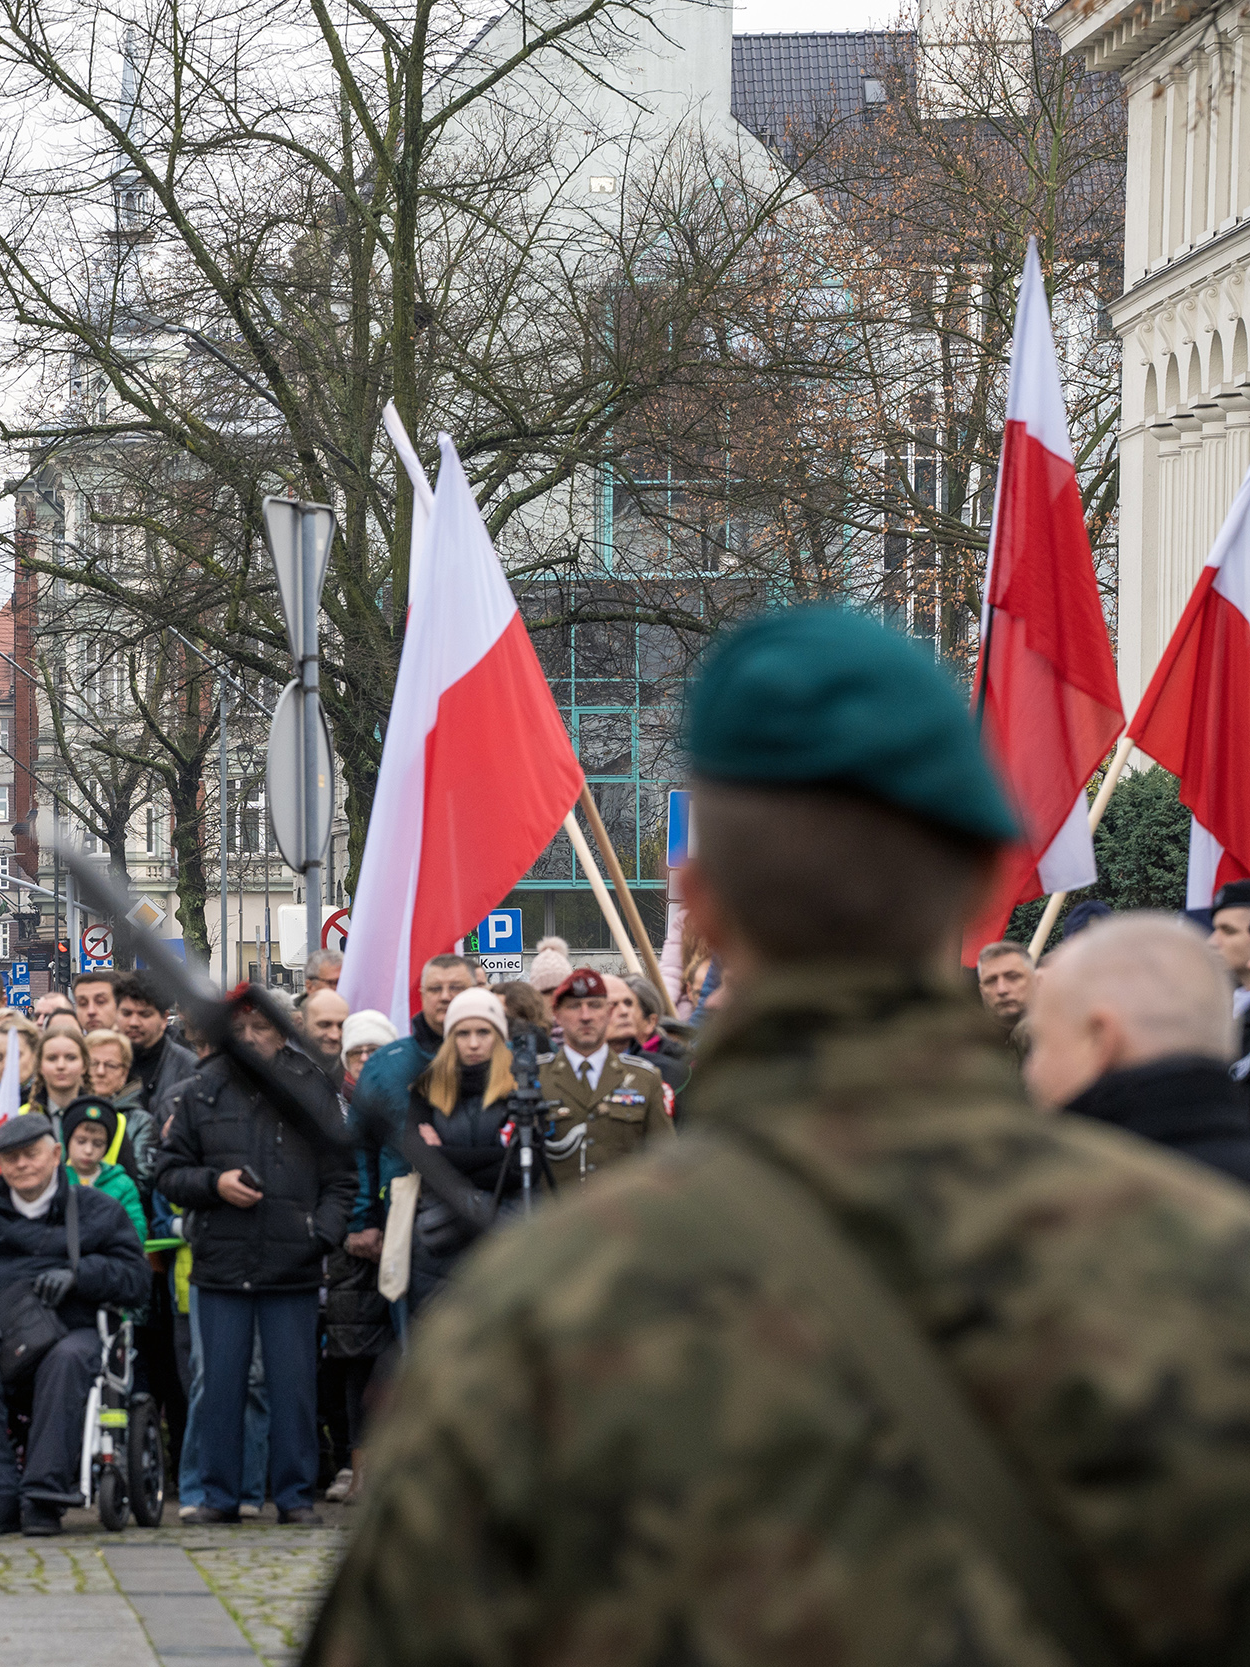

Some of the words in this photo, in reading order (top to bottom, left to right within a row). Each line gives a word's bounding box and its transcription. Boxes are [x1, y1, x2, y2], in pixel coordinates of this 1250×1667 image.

[488, 914, 513, 948] P
[480, 958, 520, 969] Koniec
[16, 965, 26, 978] P
